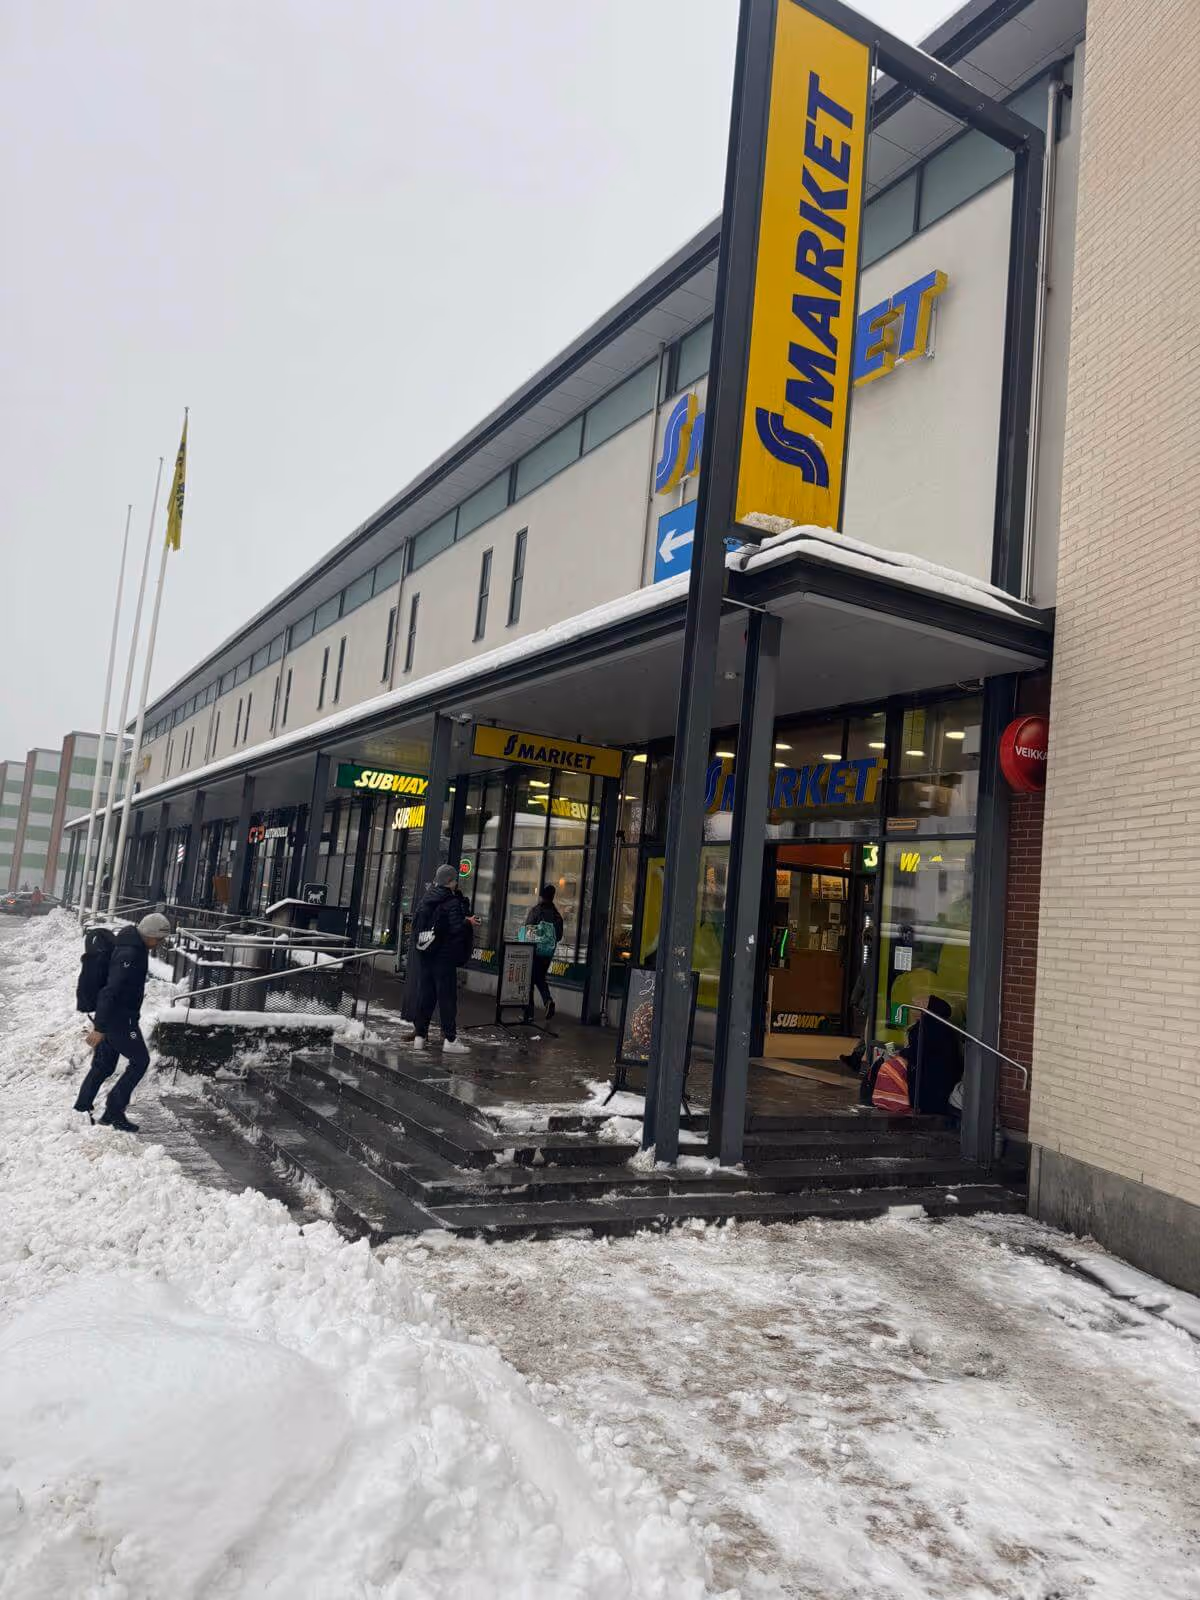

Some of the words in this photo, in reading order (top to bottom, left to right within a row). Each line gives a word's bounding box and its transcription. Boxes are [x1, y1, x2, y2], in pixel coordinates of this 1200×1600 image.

[785, 70, 854, 429] MARKET
[517, 743, 595, 769] MARKET
[354, 770, 429, 795] SUBWAY
[773, 1013, 825, 1029] SUBWAY
